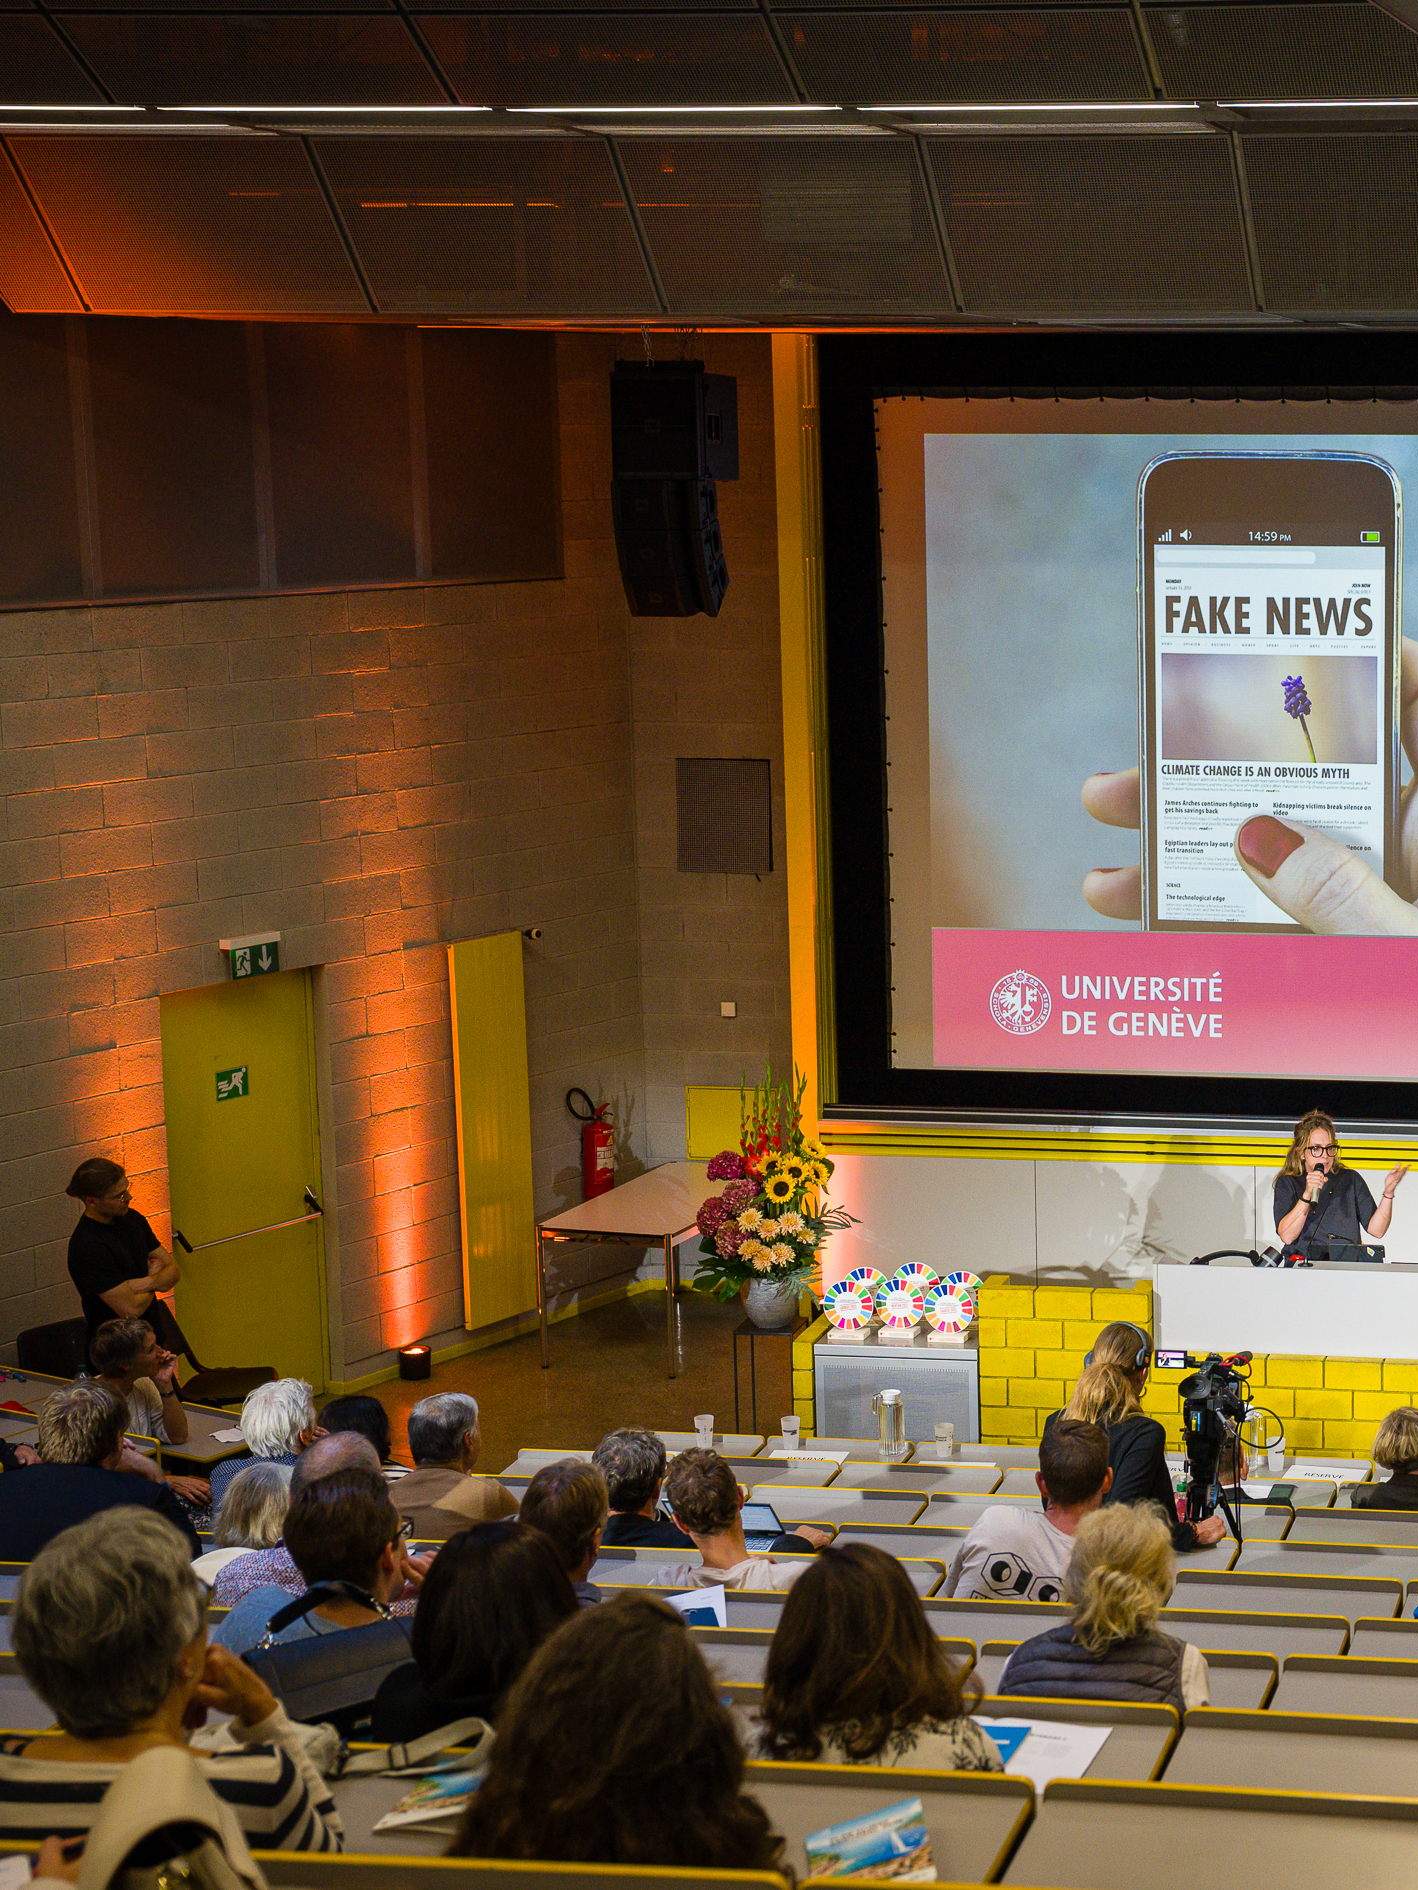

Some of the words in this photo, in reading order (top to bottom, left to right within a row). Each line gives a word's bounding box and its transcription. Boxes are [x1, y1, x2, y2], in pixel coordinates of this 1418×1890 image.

[1248, 531, 1278, 542] 14:59
[1165, 596, 1250, 634] FAKE
[1266, 597, 1373, 636] NEWS
[1161, 764, 1200, 776] CLIMATE
[1203, 765, 1242, 776] CHANGE
[1245, 766, 1254, 776] IS
[1257, 767, 1270, 777] AN
[1274, 767, 1318, 778] OBVIOUS
[1321, 768, 1350, 778] MYTH
[1273, 802, 1304, 810] Kidnapping
[1061, 971, 1223, 1002] UNIVERSITÉ
[1062, 1010, 1097, 1035] DE
[1108, 1006, 1223, 1038] GENÈVE
